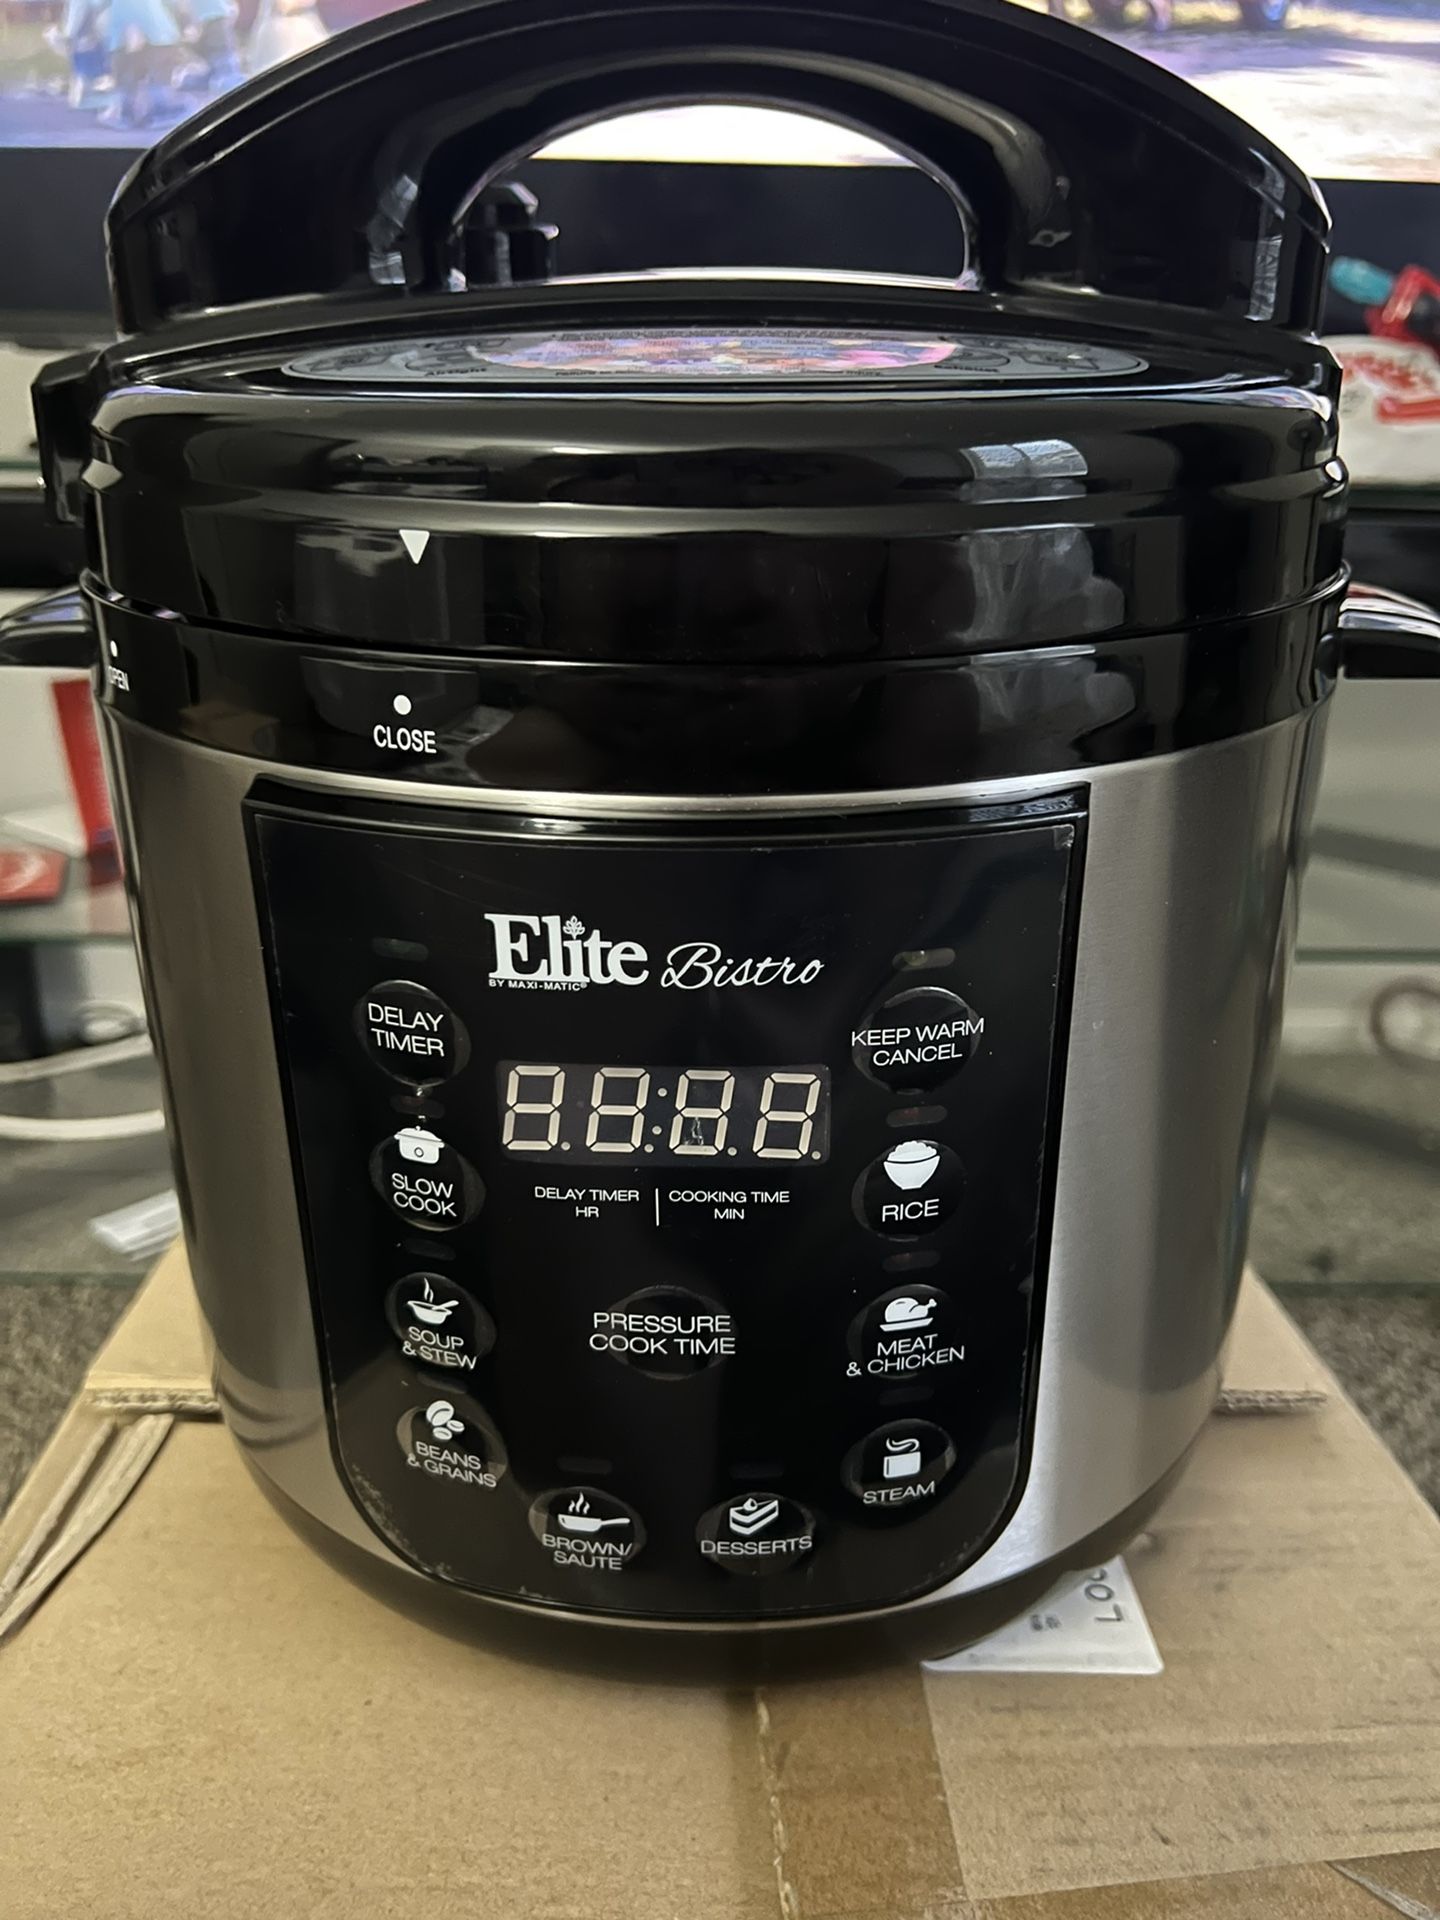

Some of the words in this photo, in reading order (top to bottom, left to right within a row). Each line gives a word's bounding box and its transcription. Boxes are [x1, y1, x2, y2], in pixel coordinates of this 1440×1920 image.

[373, 724, 437, 753] CLOSE
[484, 913, 650, 985] Elite
[660, 942, 825, 990] Bistro
[488, 979, 505, 987] BY
[368, 1002, 444, 1032] DELAY
[371, 1028, 445, 1057] TIMER
[851, 1027, 911, 1046] KEEP
[915, 1018, 985, 1042] WARM
[872, 1043, 963, 1066] CANCEL
[391, 1173, 454, 1199] SLOW
[534, 1186, 586, 1201] DELAY
[589, 1189, 640, 1202] TIMER
[668, 1190, 747, 1203] COOKING
[751, 1191, 791, 1203] TIME
[393, 1191, 457, 1217] COOK
[575, 1206, 600, 1218] HR
[714, 1208, 746, 1220] MIN
[881, 1198, 940, 1222] RICE
[593, 1312, 732, 1333] PRESSURE
[407, 1326, 465, 1350] SOUP
[589, 1333, 668, 1355] COOK
[673, 1337, 736, 1355] TIME
[876, 1333, 938, 1357] MEAT
[402, 1340, 418, 1357] &
[420, 1346, 478, 1371] STEW
[846, 1360, 862, 1377] &
[867, 1345, 966, 1375] CHICKEN
[416, 1441, 482, 1470] BEANS
[407, 1453, 421, 1468] &
[424, 1459, 498, 1488] GRAINS
[862, 1480, 937, 1506] STEAM
[542, 1533, 633, 1557] BROWN/
[700, 1535, 813, 1556] DESSERTS
[553, 1550, 623, 1571] SAUTE
